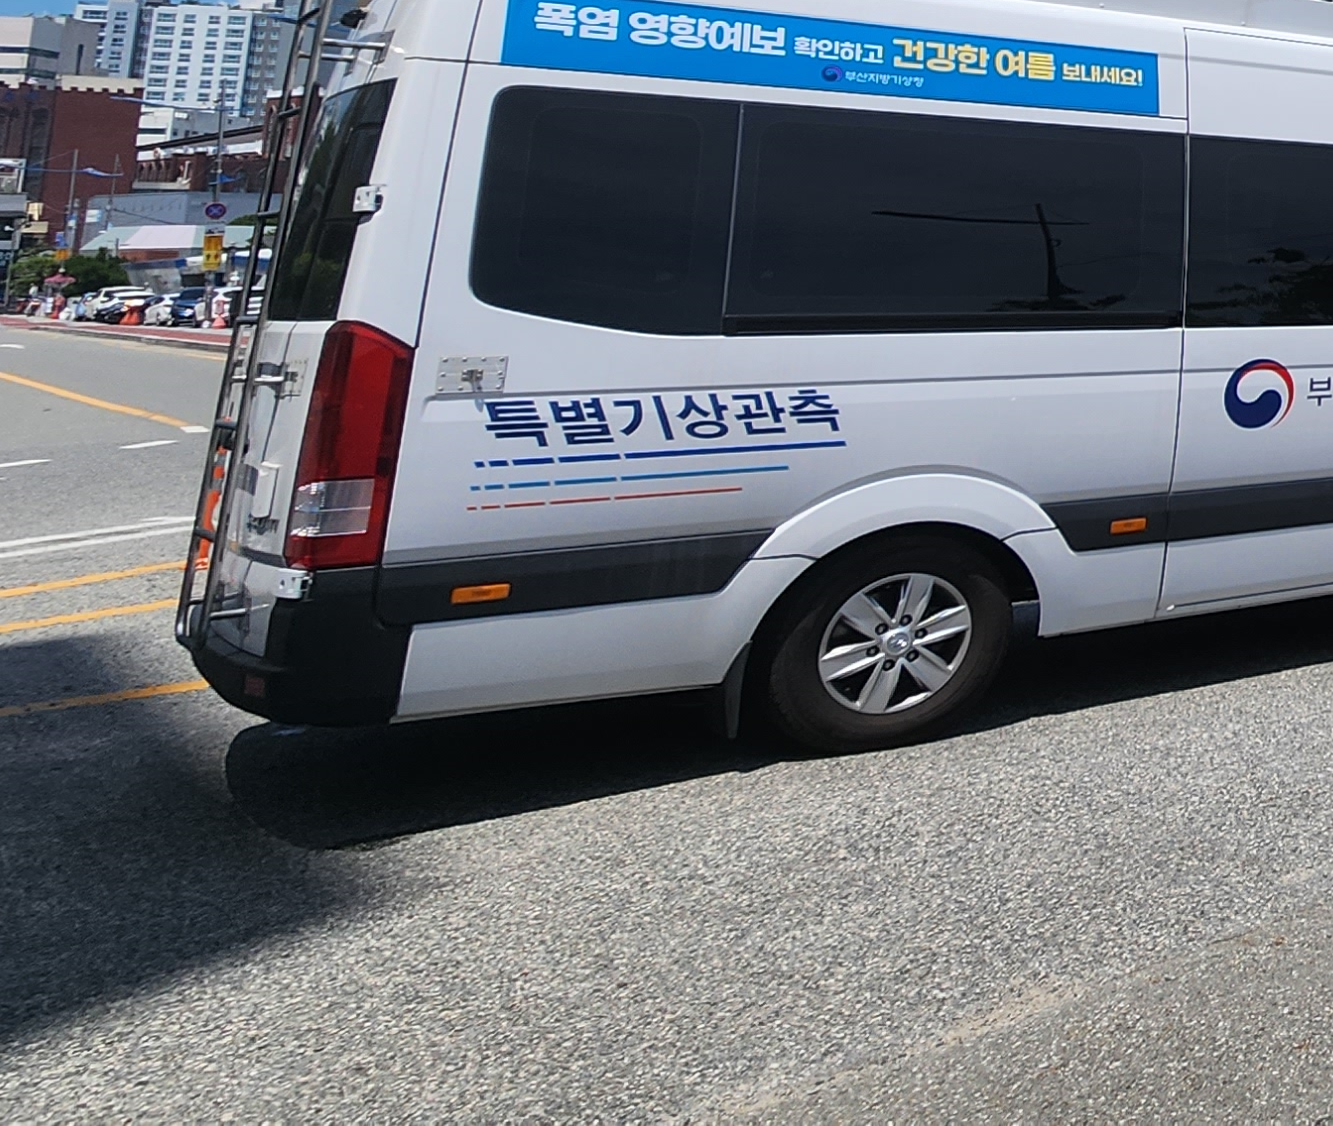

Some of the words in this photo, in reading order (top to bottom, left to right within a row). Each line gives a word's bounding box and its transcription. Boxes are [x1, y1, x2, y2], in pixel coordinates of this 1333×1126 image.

[533, 1, 619, 41] 폭염
[628, 12, 787, 56] 영향예보
[794, 36, 884, 64] 확인하고
[892, 37, 989, 75] 건강한
[994, 48, 1056, 80] 여름
[1062, 63, 1143, 87] 보내세요!
[845, 70, 925, 88] 부산지방기상청
[484, 389, 841, 448] 특별기상관측
